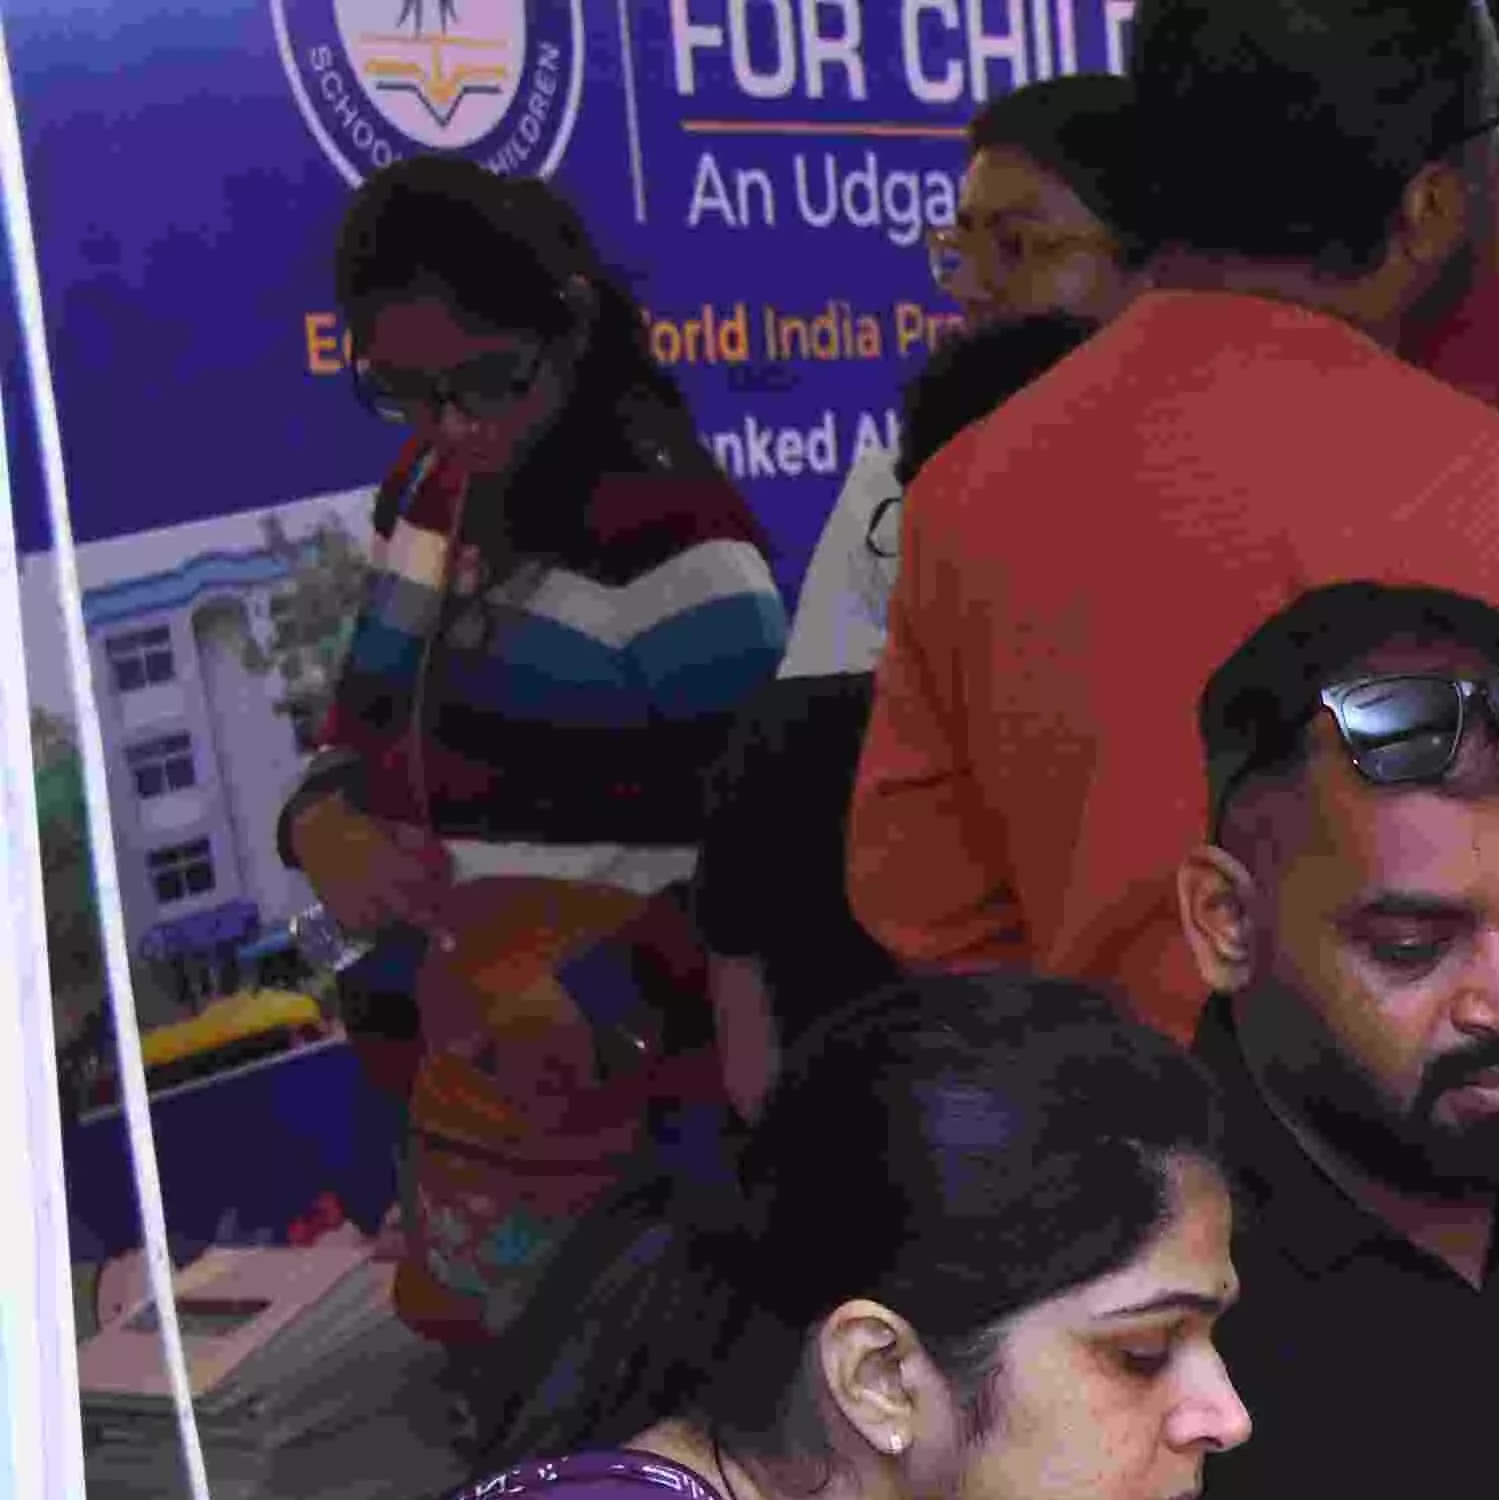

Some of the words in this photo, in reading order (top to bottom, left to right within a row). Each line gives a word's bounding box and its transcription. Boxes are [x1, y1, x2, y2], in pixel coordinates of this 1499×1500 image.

[670, 0, 868, 100] FOR
[310, 45, 402, 169] SCHOO
[480, 41, 561, 176] HILDREN
[688, 152, 776, 227] An
[794, 151, 966, 246] Udga
[643, 298, 748, 366] orld
[766, 298, 883, 362] India
